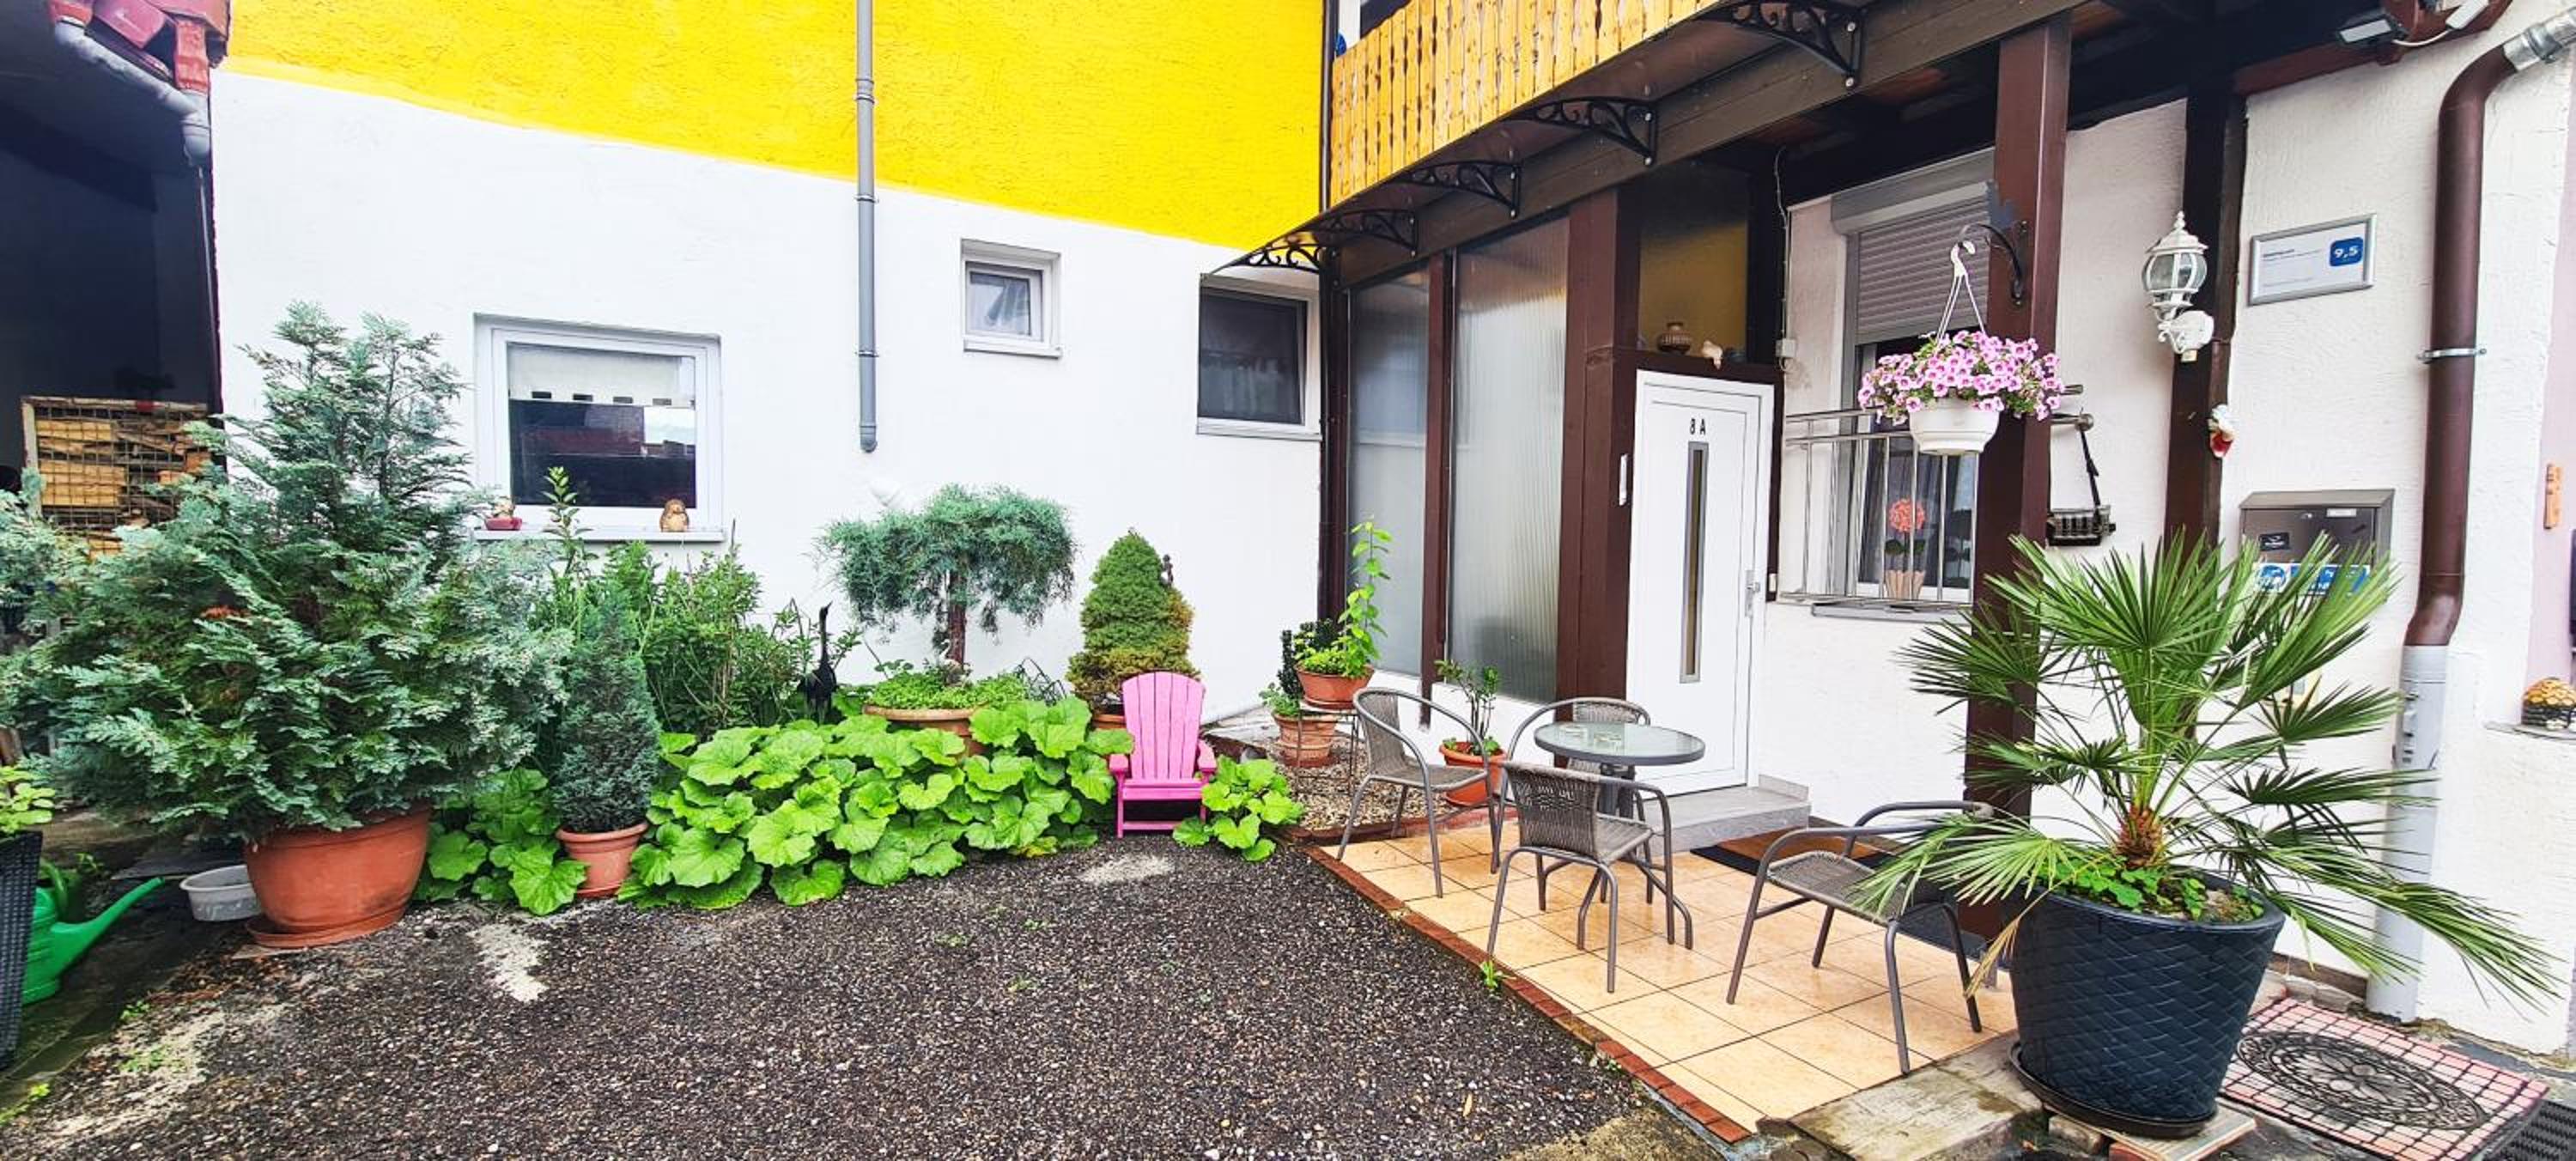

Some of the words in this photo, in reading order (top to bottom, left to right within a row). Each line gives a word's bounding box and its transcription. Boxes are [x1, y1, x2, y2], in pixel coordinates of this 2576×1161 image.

[2334, 246, 2359, 258] 9,5
[1690, 417, 1696, 435] 8
[1699, 418, 1706, 435] A
